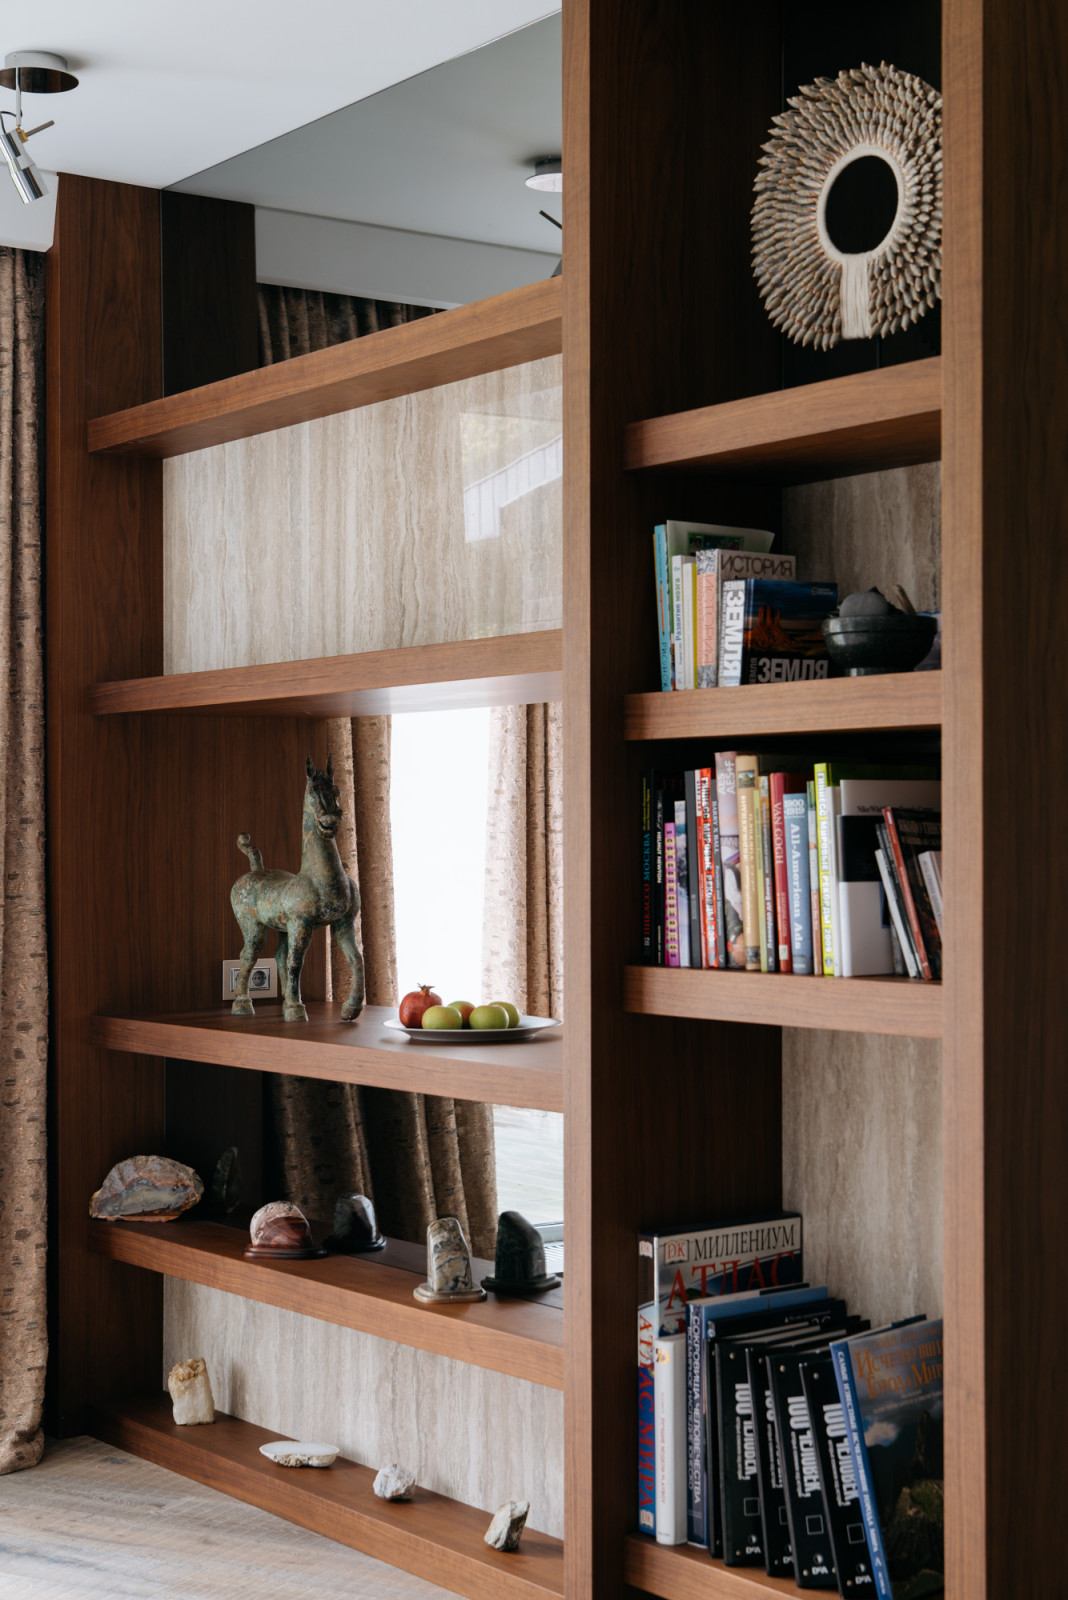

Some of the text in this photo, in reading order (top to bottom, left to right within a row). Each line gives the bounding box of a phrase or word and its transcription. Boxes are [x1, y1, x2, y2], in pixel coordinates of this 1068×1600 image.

[721, 554, 792, 576] ИСТОРИЯ
[703, 574, 715, 664] ИСТОРИЯ
[724, 591, 745, 676] ЗЕМЛЯ
[750, 658, 758, 683] ЕМЛЯ
[758, 658, 829, 683] ЗЕМЛЯ
[718, 773, 726, 796] AES
[726, 760, 736, 795] AES+F
[817, 772, 827, 816] ГИННЕСС
[701, 777, 710, 819] ГИННЕСС
[784, 799, 804, 807] 1900
[703, 822, 712, 871] МИРОВЫЕ
[773, 802, 784, 864] VAN GOGH
[820, 820, 829, 871] МИРОВЫЕ
[790, 823, 802, 917] All-American
[705, 874, 714, 921] РЕКОРДЫ
[821, 875, 831, 924] РЕКОРДЫ
[793, 922, 803, 949] Ads
[667, 1242, 687, 1259] DK
[694, 1224, 795, 1261] МИЛЛЕНИУМ
[664, 1251, 795, 1310] АТЛАС
[854, 1339, 944, 1378] ИСЧЕЗНУВШИ
[734, 1383, 752, 1415] 100
[865, 1361, 943, 1400] ГОРОДА МИР
[638, 1315, 655, 1507] АТЛАС МИРА
[692, 1315, 702, 1504] СОКРОВИЩА ЧЕЛОВЕЧЕСТВА
[787, 1396, 810, 1430] 100
[823, 1403, 846, 1437] 100
[838, 1351, 879, 1553] САМЫЕ ИЗВЕСТНЫЕ ИСЧЕЗНУВШИЕ ГОРОДА МИРА
